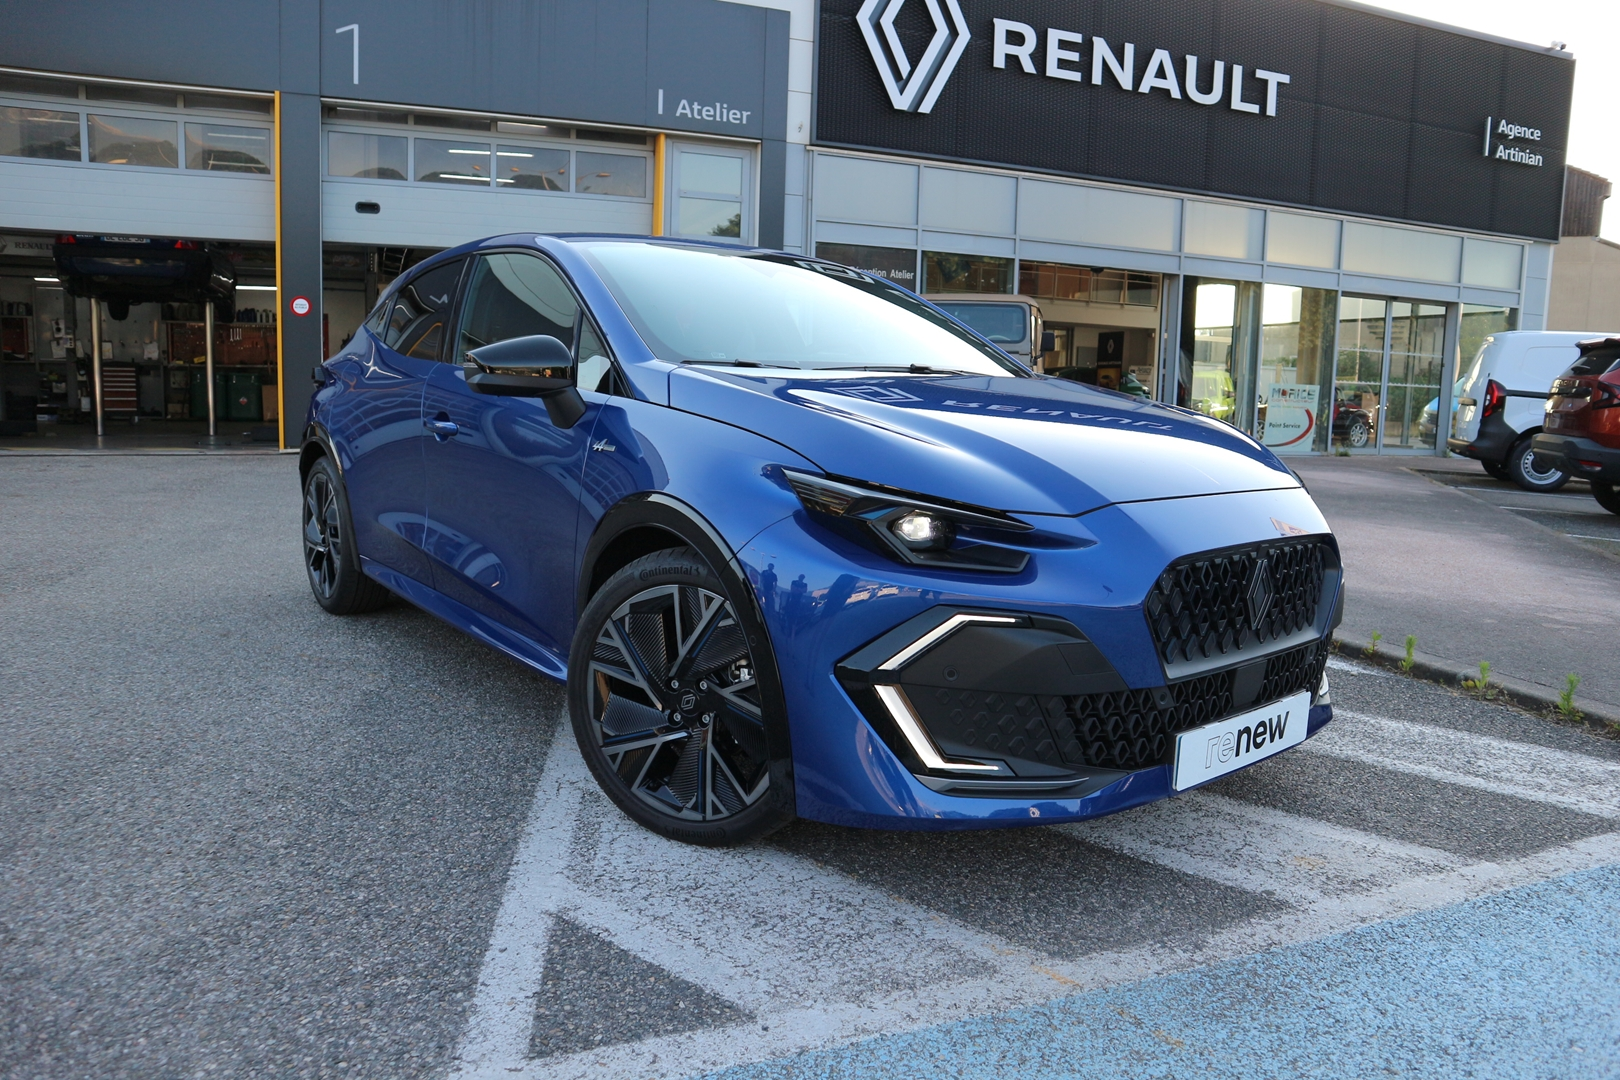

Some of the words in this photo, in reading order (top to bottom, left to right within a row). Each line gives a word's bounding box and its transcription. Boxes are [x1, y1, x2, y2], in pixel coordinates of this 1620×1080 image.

[335, 23, 359, 85] 1
[993, 18, 1290, 117] RENAULT
[675, 99, 751, 125] Atelier
[1498, 119, 1542, 141] Agence
[1496, 144, 1543, 167] Artinian
[889, 268, 915, 280] Atelier
[639, 564, 693, 581] Continental
[1205, 710, 1290, 769] renew
